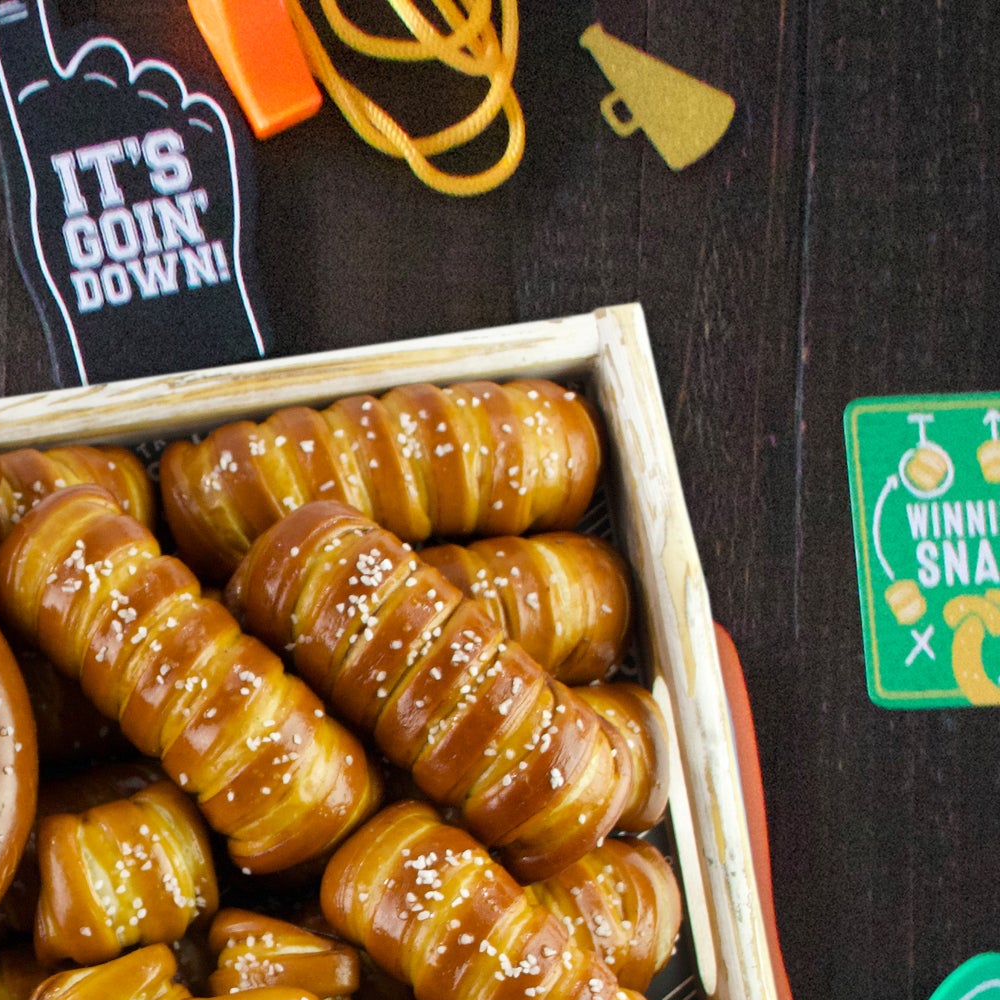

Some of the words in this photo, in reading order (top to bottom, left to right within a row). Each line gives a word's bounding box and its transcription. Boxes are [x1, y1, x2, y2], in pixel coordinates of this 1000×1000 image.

[51, 128, 193, 218] IT'S
[62, 188, 209, 270] GOIN'
[70, 241, 231, 313] DOWN!
